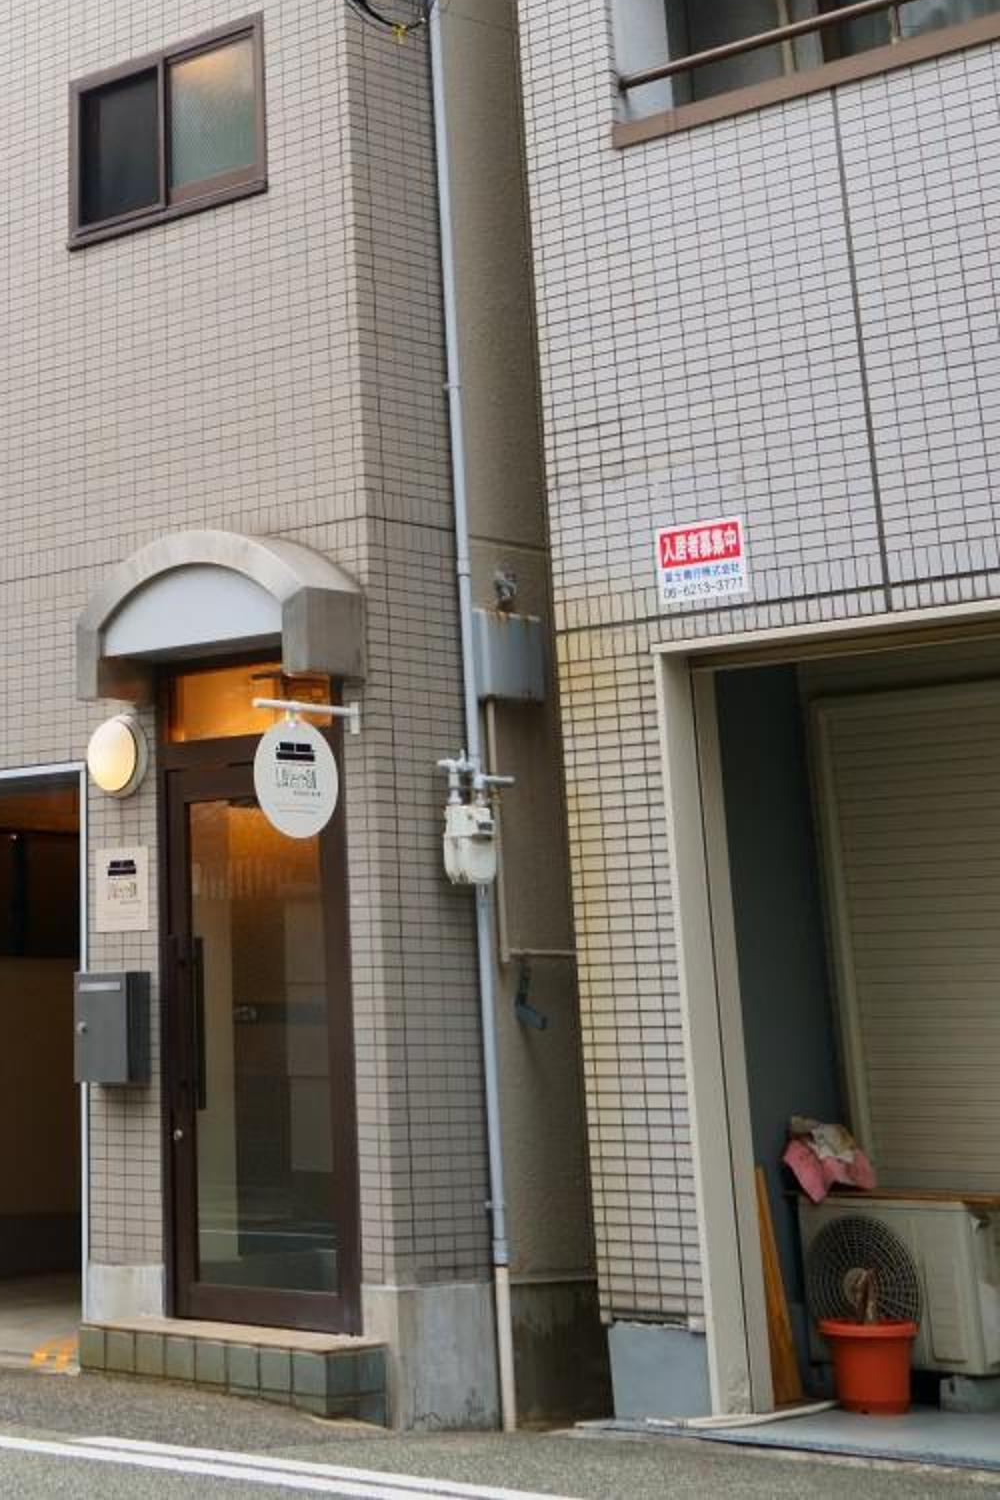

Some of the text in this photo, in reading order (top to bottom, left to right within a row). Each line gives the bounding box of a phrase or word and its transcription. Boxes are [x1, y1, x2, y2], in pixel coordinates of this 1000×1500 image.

[663, 526, 737, 563] 入居者募集中
